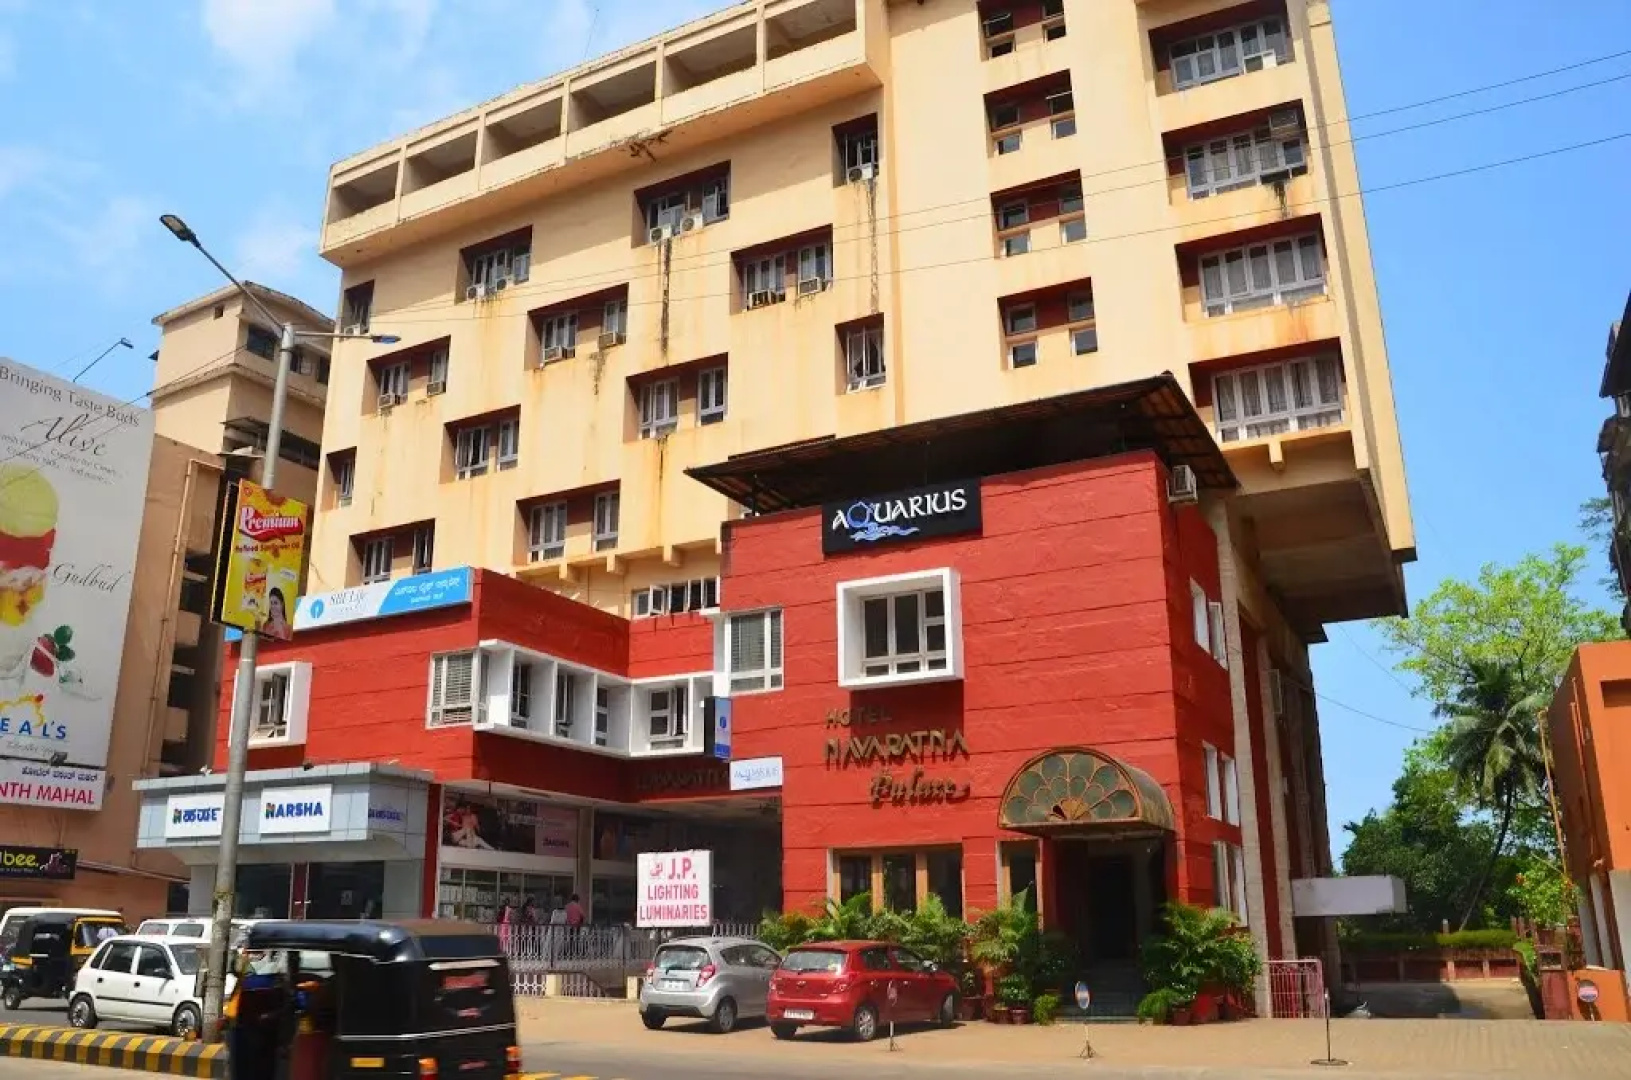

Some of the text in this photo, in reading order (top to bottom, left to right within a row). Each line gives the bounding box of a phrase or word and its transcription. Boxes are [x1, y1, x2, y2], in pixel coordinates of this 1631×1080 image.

[0, 365, 139, 427] Bringing Taste Buds
[20, 413, 107, 456] Alive
[240, 506, 300, 536] Premium
[832, 488, 967, 531] AQUARIUS
[826, 705, 893, 728] HOTEL
[825, 728, 970, 771] NAVARATNA
[36, 784, 95, 804] MAHAL
[265, 801, 323, 820] HARSHA
[668, 857, 697, 880] J.P.
[647, 884, 699, 900] LIGHTING
[639, 904, 708, 921] LUMINARIES
